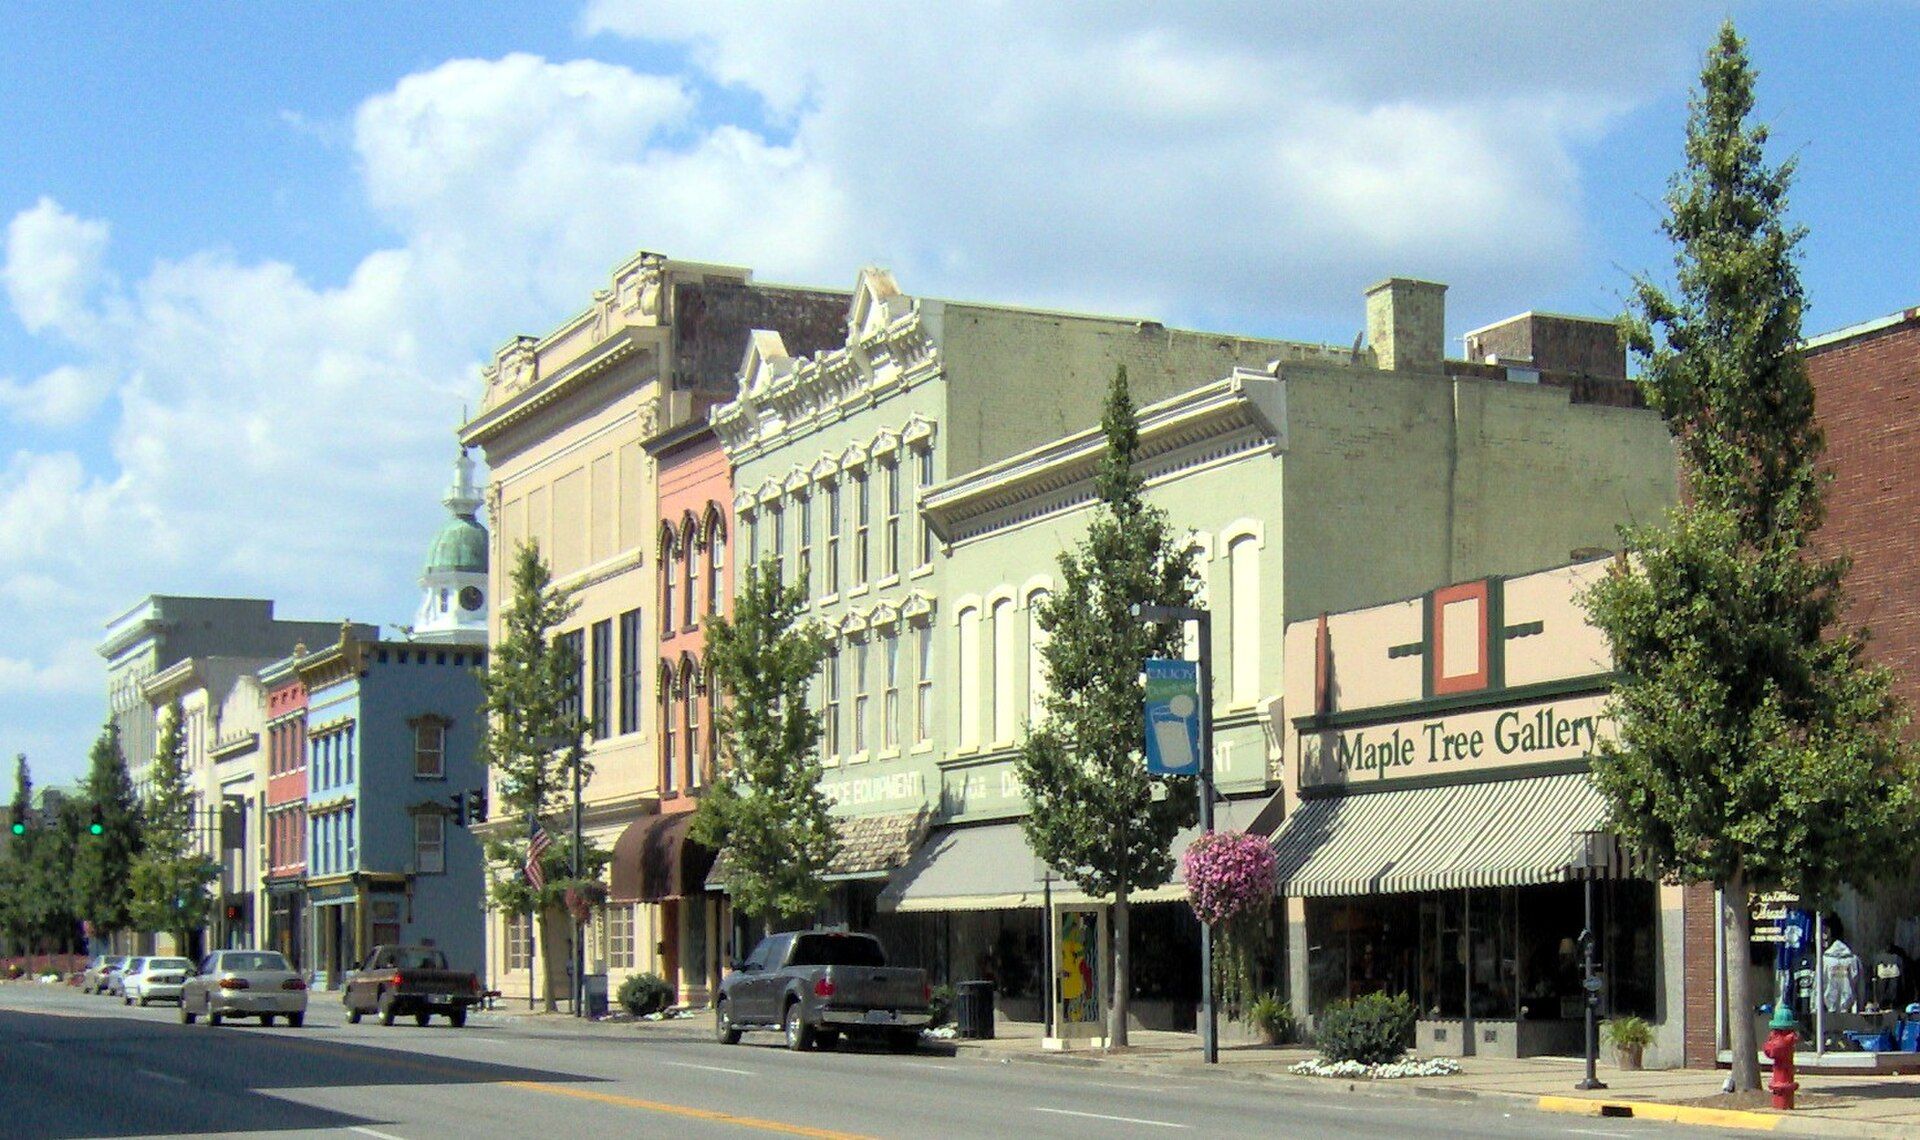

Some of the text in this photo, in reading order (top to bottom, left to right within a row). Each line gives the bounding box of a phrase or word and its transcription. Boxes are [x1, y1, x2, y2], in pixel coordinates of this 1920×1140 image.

[1338, 706, 1606, 779] Maple Tree Gallery
[853, 770, 919, 805] EQUIPMENT
